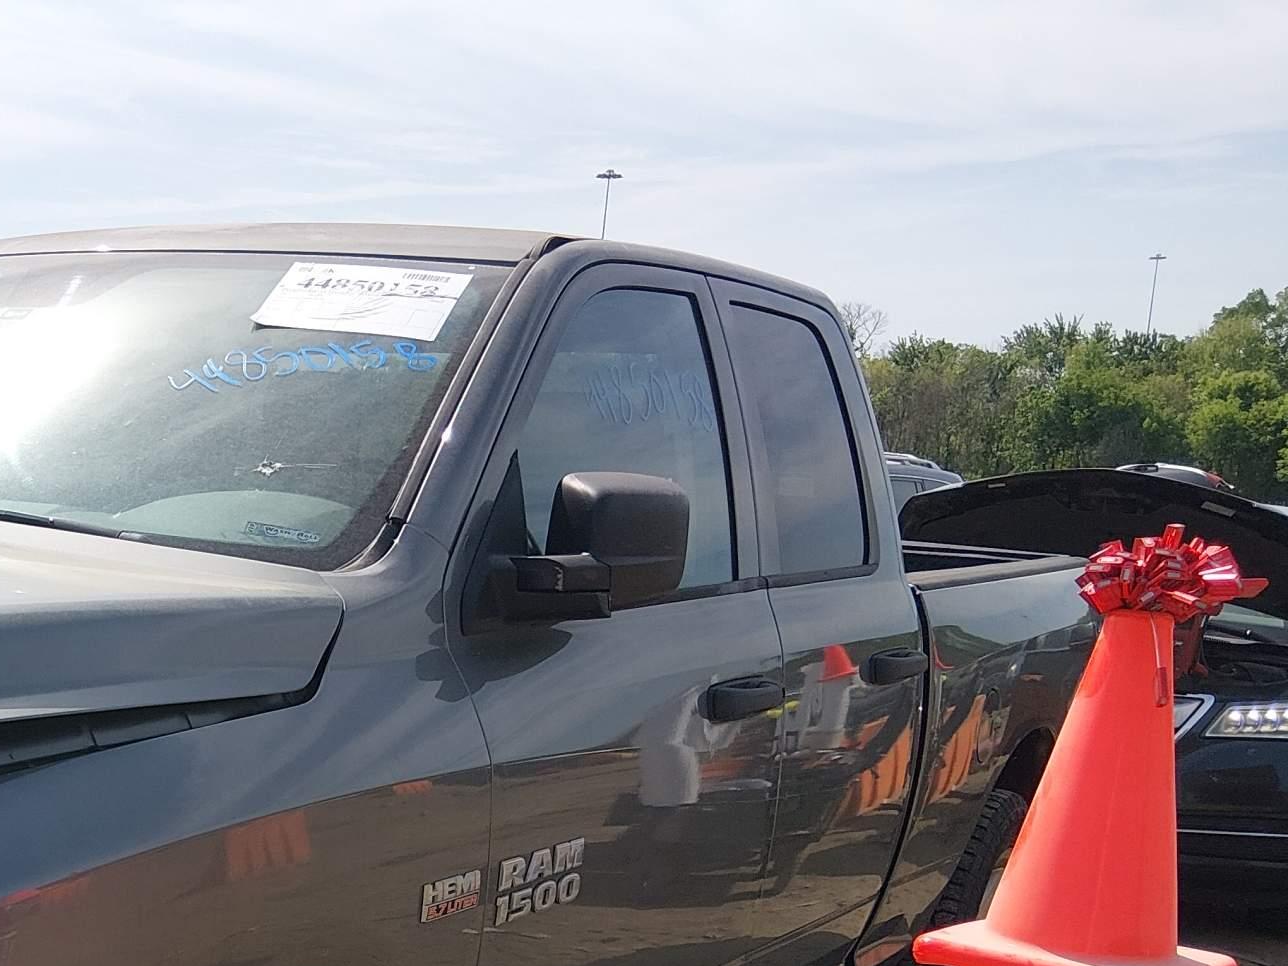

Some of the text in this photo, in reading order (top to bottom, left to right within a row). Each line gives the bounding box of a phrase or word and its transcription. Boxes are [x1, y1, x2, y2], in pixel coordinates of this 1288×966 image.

[168, 339, 439, 393] 44850158
[423, 869, 481, 906] HEMI
[498, 837, 585, 892] RAM
[495, 873, 581, 926] 1500
